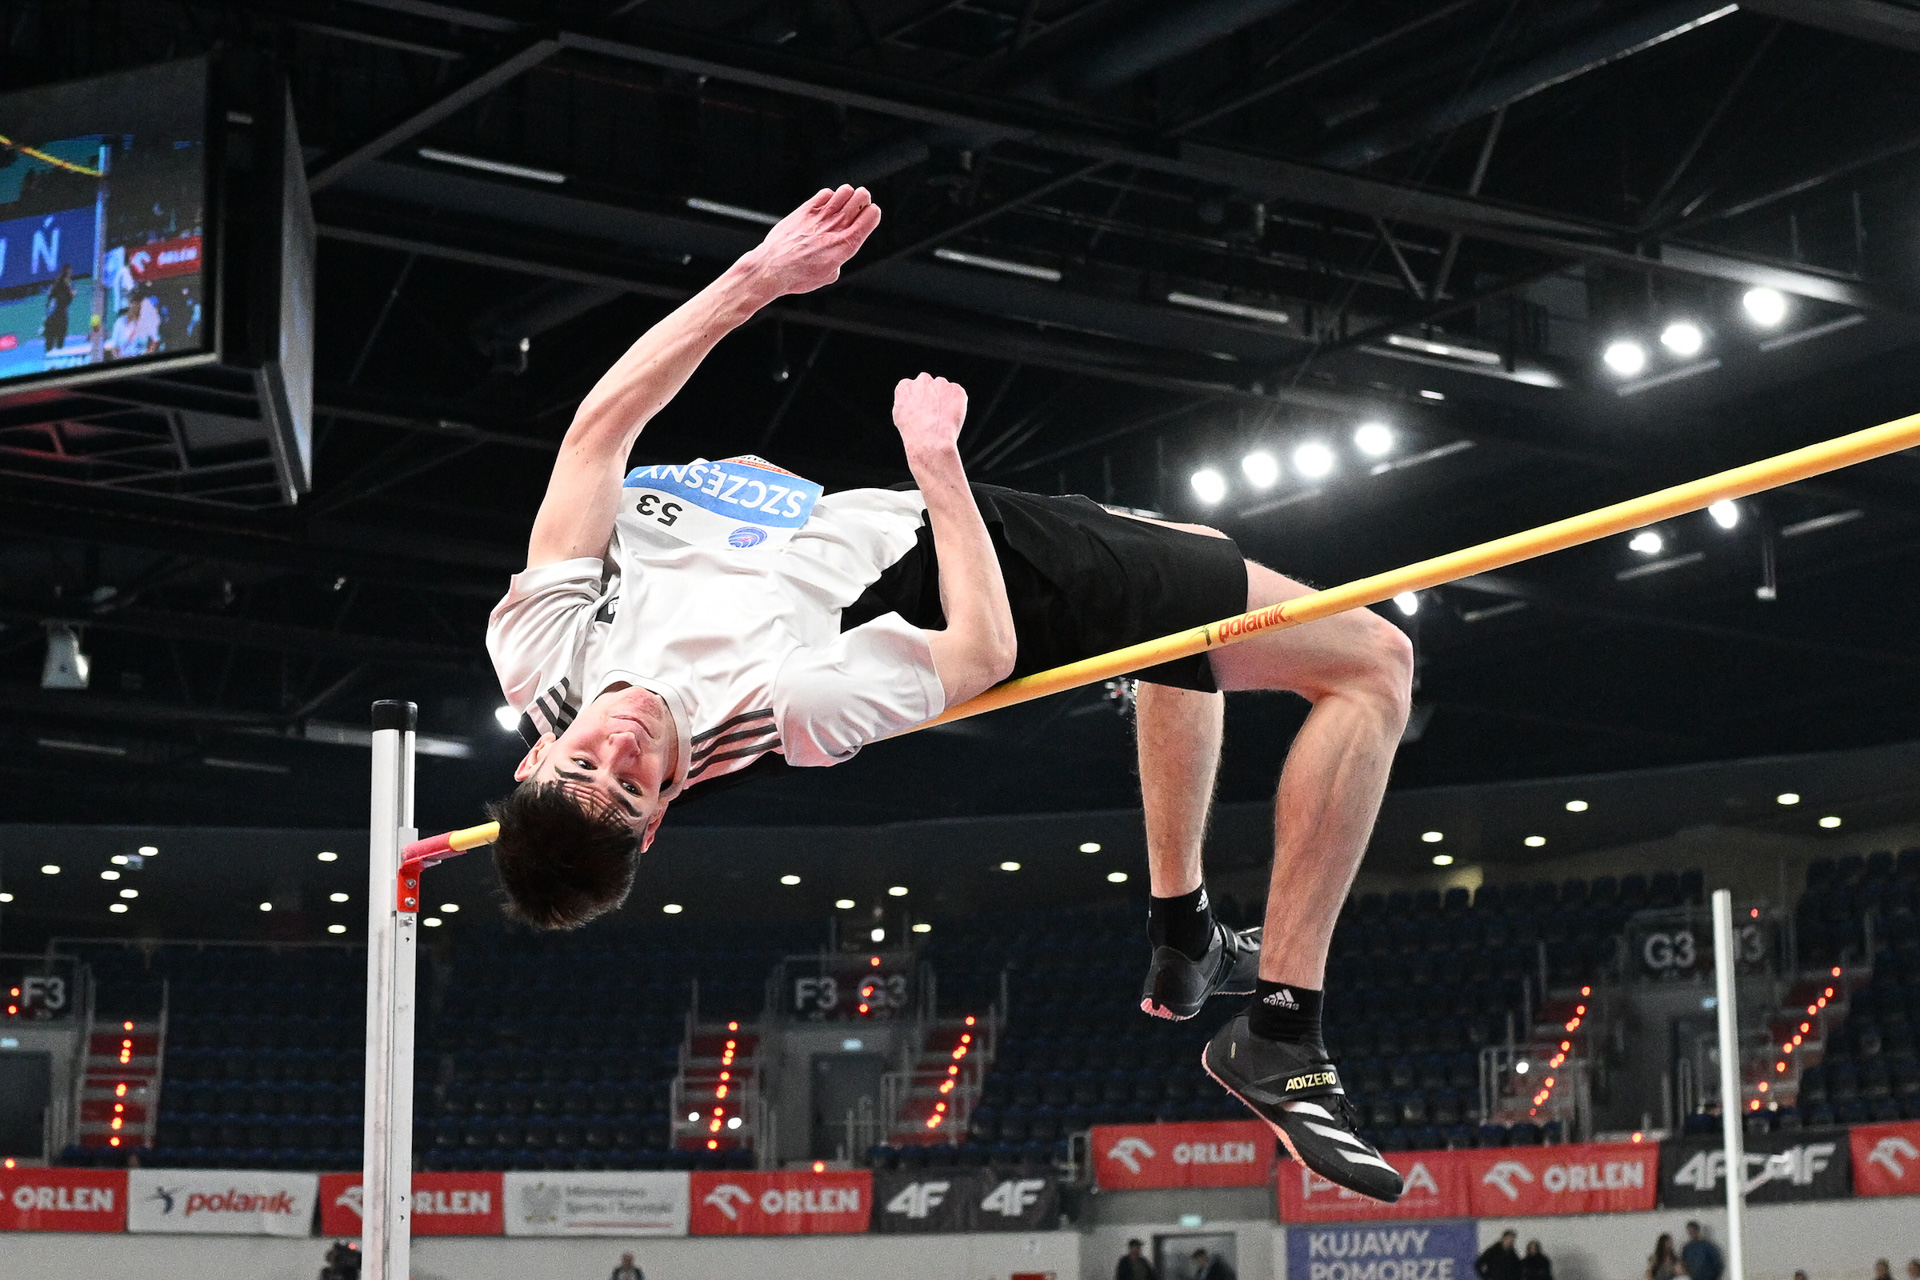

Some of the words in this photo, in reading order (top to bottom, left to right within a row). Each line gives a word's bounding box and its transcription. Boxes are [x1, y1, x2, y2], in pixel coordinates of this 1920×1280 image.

[636, 494, 683, 527] 53
[1218, 604, 1287, 644] polanik
[1644, 930, 1696, 969] G3
[22, 976, 66, 1010] F3
[795, 976, 838, 1010] F3
[858, 973, 908, 1008] G3
[1262, 996, 1300, 1011] adidas
[1285, 1071, 1337, 1093] ADIZERO
[1172, 1141, 1256, 1166] ORLEN
[1302, 1162, 1438, 1199] PA
[1542, 1160, 1645, 1193] ORLEN
[13, 1186, 114, 1213] ORLEN
[184, 1188, 293, 1217] polanik
[411, 1190, 490, 1216] RLEN
[760, 1187, 860, 1215] ORLEN
[886, 1181, 951, 1219] 4F
[980, 1178, 1045, 1217] 4F
[1308, 1229, 1431, 1259] KUJAWY
[1308, 1258, 1456, 1280] POMORZE
